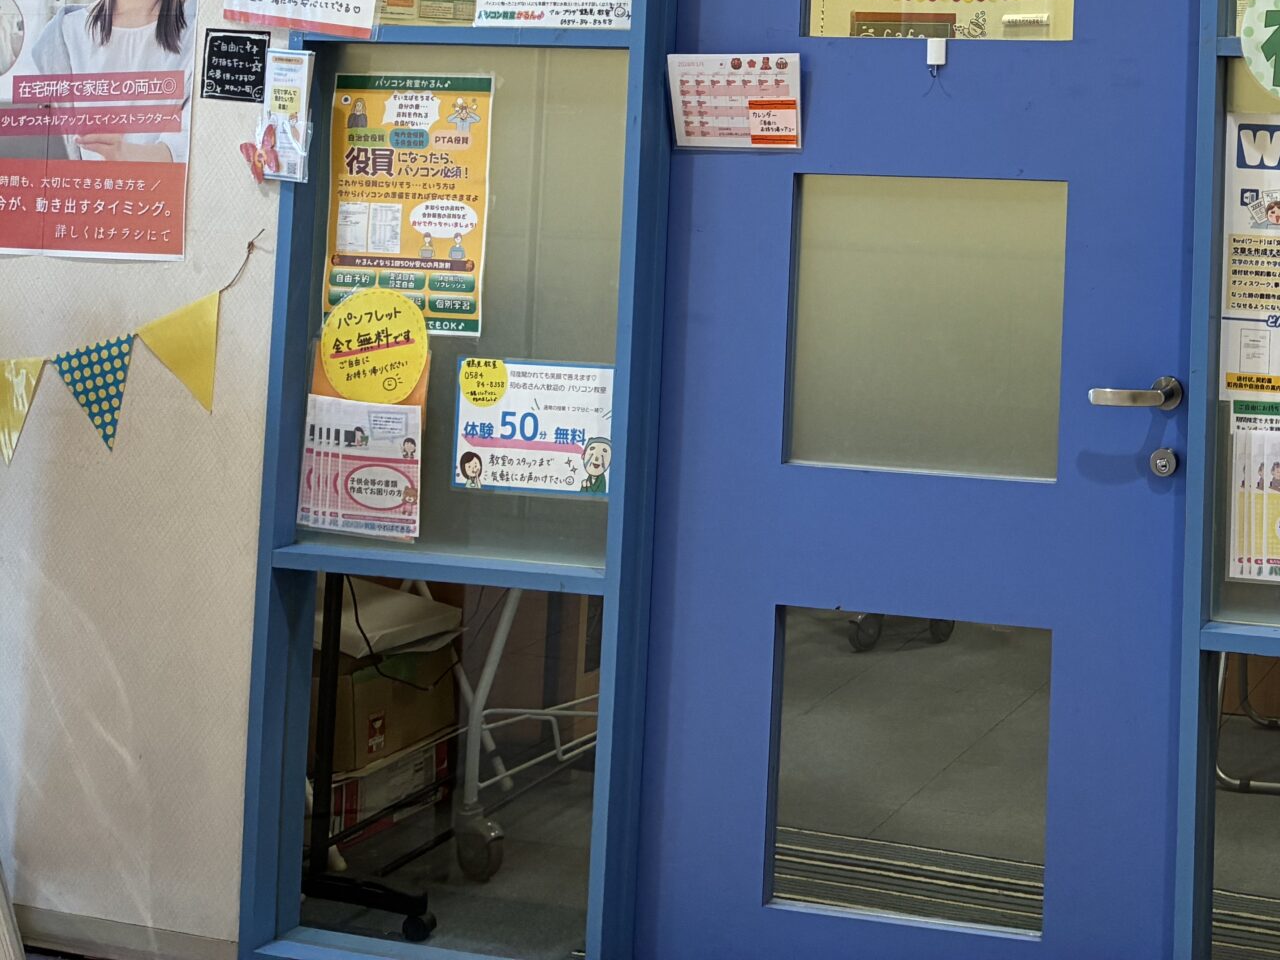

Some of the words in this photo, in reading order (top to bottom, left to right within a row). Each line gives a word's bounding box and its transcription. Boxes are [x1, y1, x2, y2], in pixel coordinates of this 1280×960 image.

[1, 112, 180, 128] 少しずつスキルアップしてインストラクターへ
[434, 135, 469, 145] PTA役員
[345, 146, 395, 178] 役員
[397, 166, 469, 179] パソコン必須!
[55, 224, 171, 242] 詳しくはチラシにて
[336, 274, 370, 284] 自由予約
[435, 300, 470, 310] 個別学習
[337, 306, 403, 330] パンフレット
[332, 327, 411, 354] 全て無料です
[338, 356, 370, 370] ご自由に
[464, 421, 494, 439] 体験
[554, 426, 586, 445] 無料
